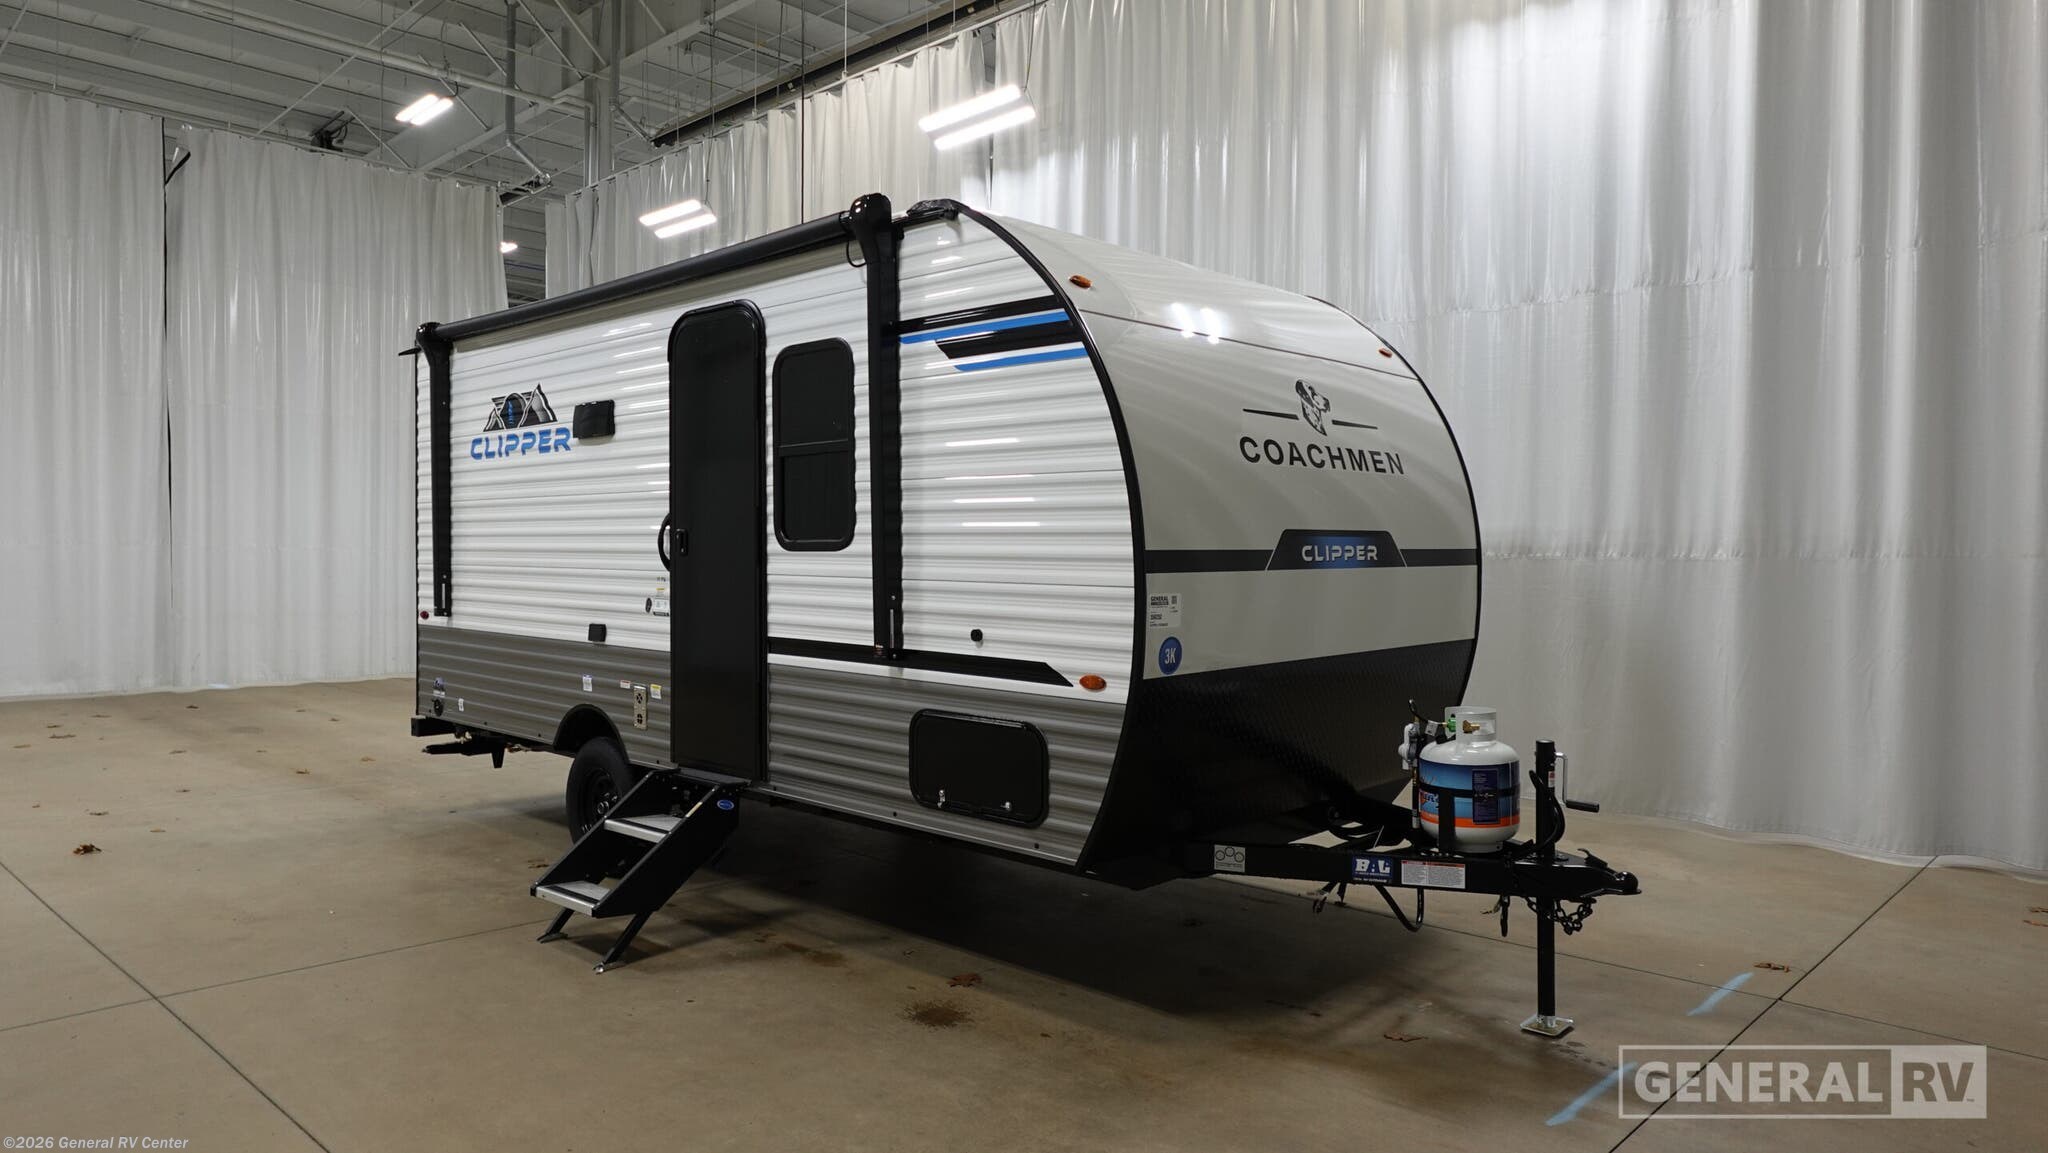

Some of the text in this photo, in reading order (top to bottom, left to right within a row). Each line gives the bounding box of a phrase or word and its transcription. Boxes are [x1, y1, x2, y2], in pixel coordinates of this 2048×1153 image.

[470, 426, 572, 461] CLIPPER
[1239, 436, 1405, 475] COACHMEN
[1301, 544, 1378, 563] CLIPPER
[1164, 647, 1177, 665] 3K
